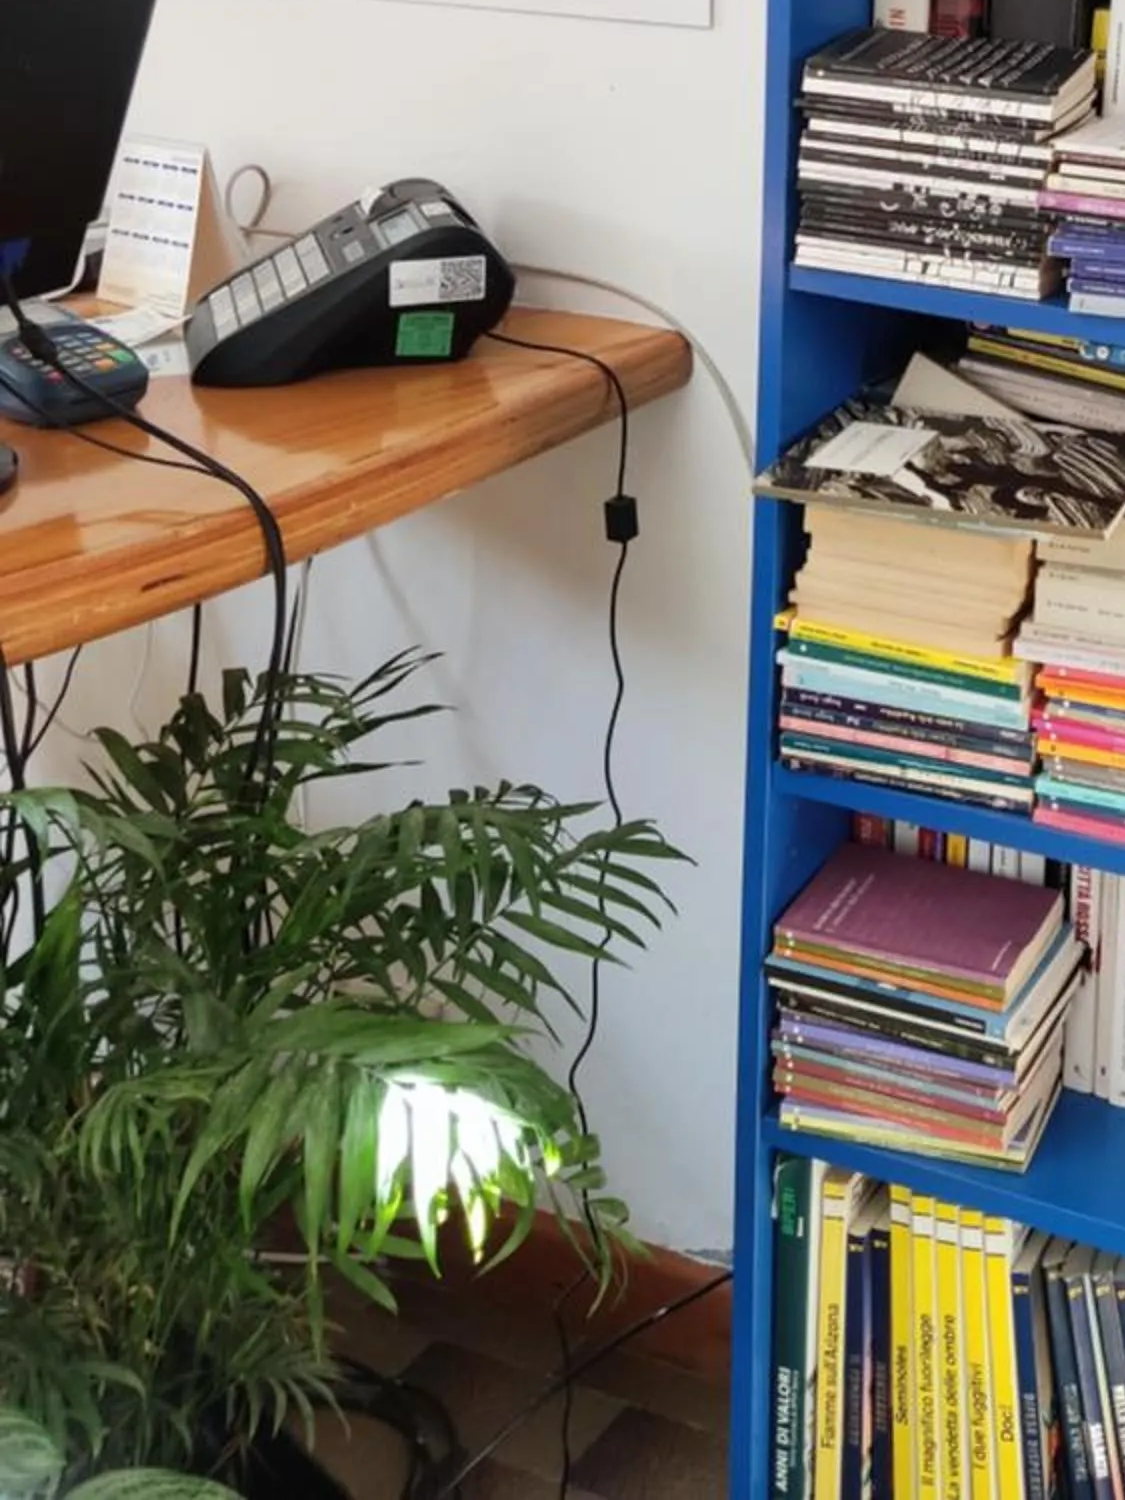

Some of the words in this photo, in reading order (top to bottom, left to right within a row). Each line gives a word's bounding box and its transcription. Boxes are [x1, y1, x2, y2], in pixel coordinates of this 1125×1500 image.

[918, 1313, 934, 1395] fuorilegge
[944, 1314, 956, 1365] ombre
[778, 1366, 792, 1424] VALORI
[896, 1345, 907, 1426] Seminoles
[945, 1368, 957, 1407] delle
[970, 1362, 987, 1425] fuggitivi
[780, 1426, 792, 1446] DI
[820, 1388, 836, 1449] Fiamme
[920, 1398, 936, 1474] magnifico
[947, 1409, 960, 1477] vendetta
[974, 1430, 986, 1462] due
[774, 1451, 790, 1492] ANNI
